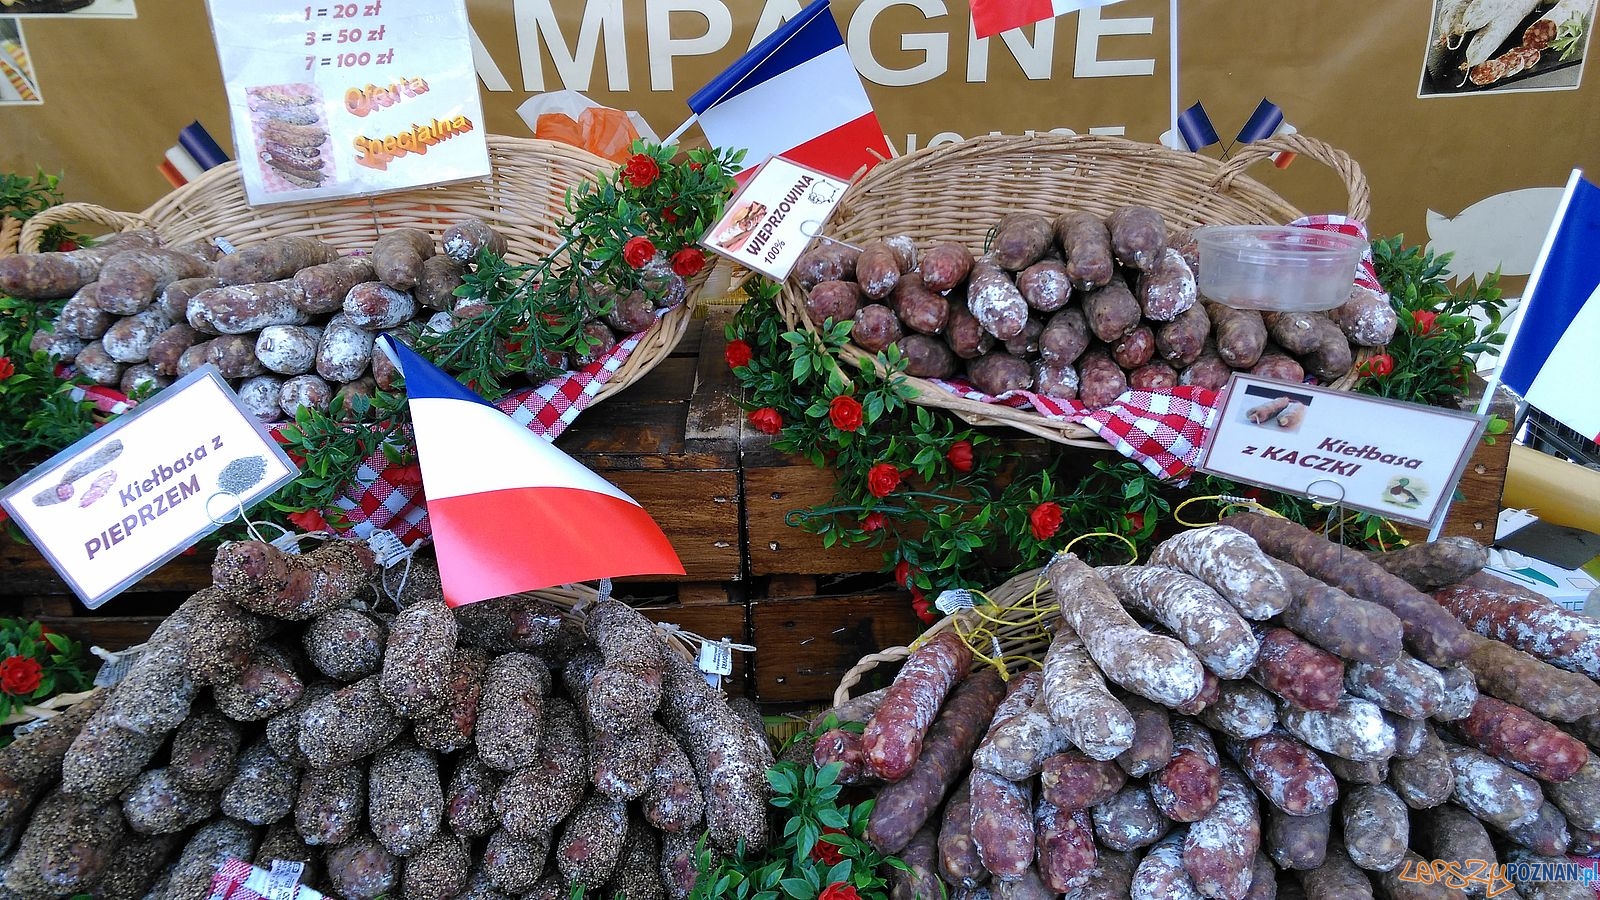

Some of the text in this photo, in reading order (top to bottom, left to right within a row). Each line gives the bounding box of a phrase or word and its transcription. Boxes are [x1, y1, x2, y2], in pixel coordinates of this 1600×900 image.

[304, 6, 312, 21] 1
[333, 3, 358, 19] 20
[363, 0, 382, 17] zł
[304, 31, 316, 46] 3
[337, 28, 362, 44] 50
[367, 24, 386, 42] zł
[305, 55, 316, 71] 7
[337, 51, 371, 68] 100
[376, 48, 395, 65] zł
[344, 76, 430, 118] Oferta
[353, 115, 474, 171] Specjalna
[746, 174, 814, 256] WIEPRZOWINA
[764, 239, 786, 265] 100%
[1241, 445, 1362, 478] z KACZKI
[1316, 437, 1424, 471] Kiełbasa
[118, 435, 224, 508] Kiełbasa z
[84, 474, 201, 561] PIEPRZEM
